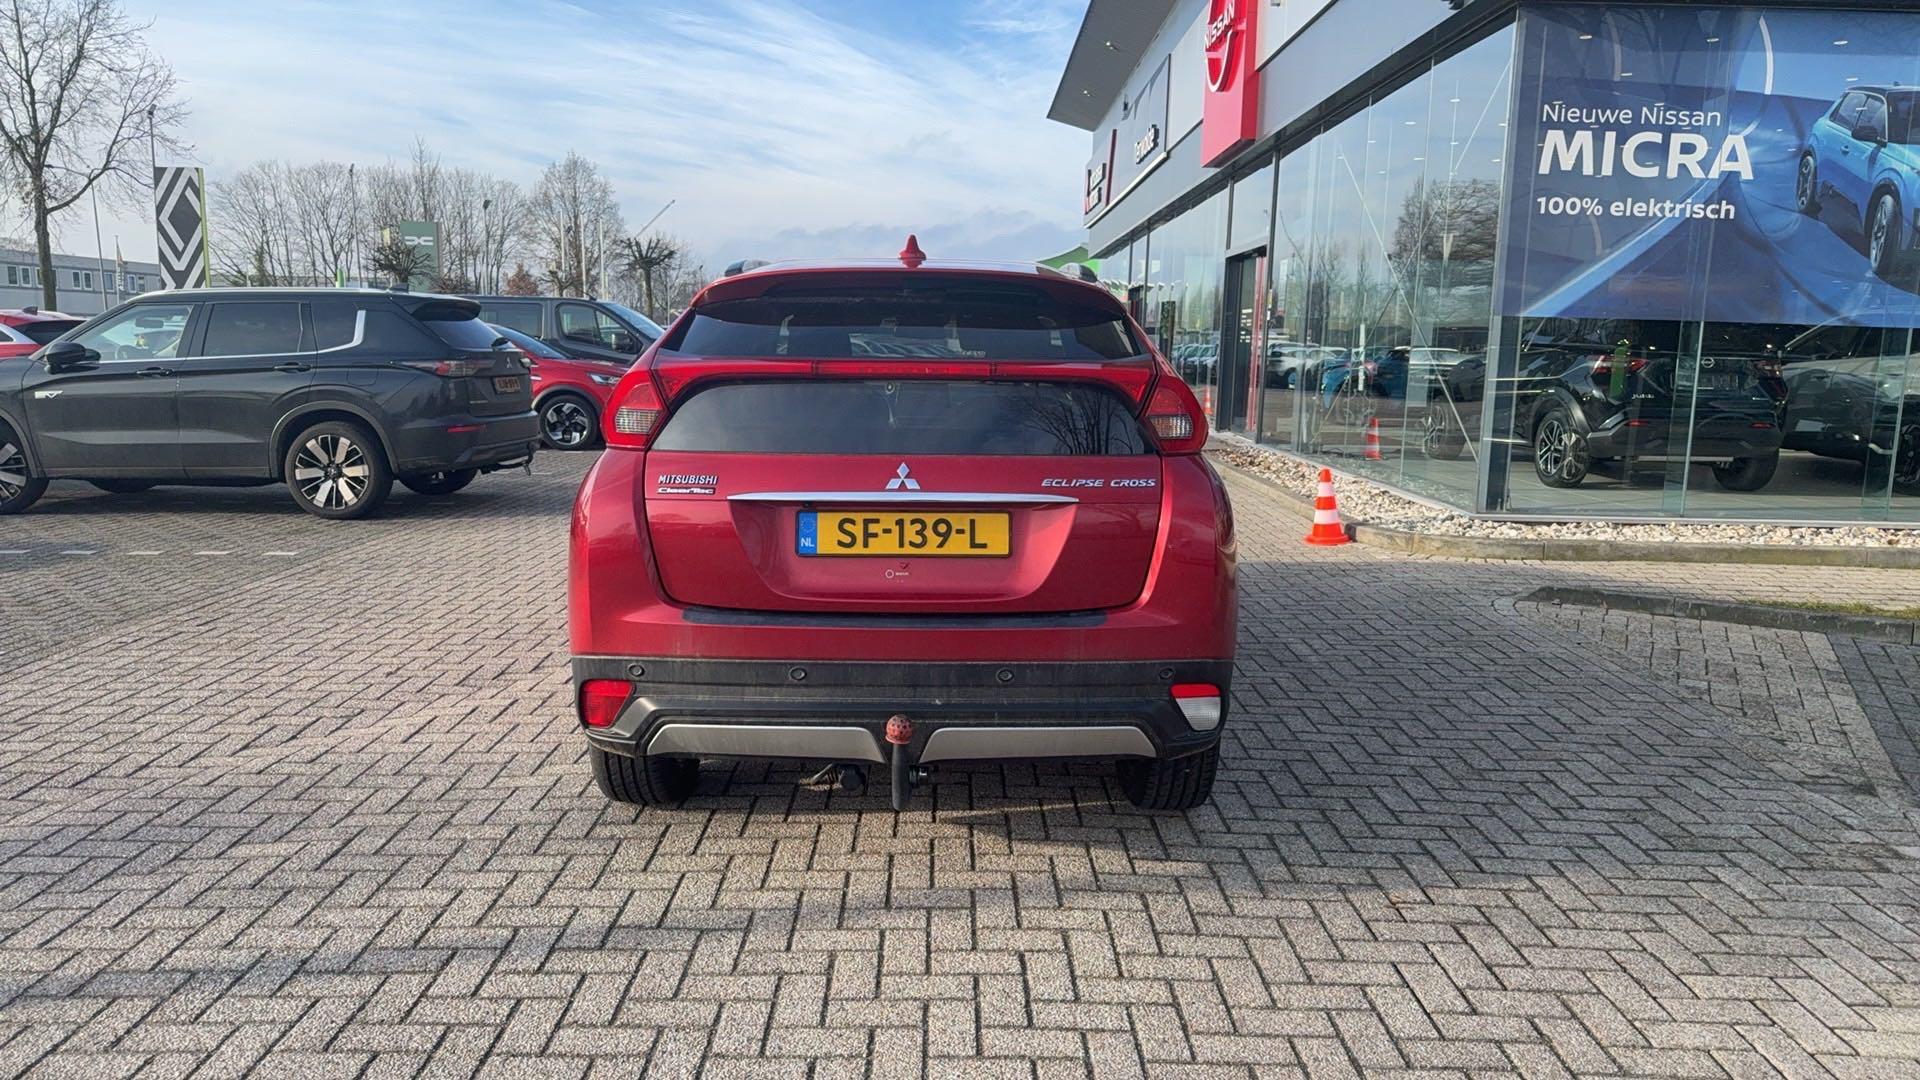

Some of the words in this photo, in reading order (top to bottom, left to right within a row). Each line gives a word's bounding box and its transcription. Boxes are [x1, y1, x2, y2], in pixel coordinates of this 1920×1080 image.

[1203, 2, 1235, 49] NISSAN
[1542, 103, 1633, 125] Nieuwe
[1640, 105, 1722, 127] Nissan
[1537, 129, 1755, 180] MICRA
[1537, 196, 1604, 217] 100%
[1609, 198, 1736, 220] elektrisch
[658, 474, 718, 485] MITSUBISHI
[1041, 478, 1104, 488] ECLIPSE
[1110, 478, 1157, 488] CROSS
[800, 537, 816, 548] NL
[836, 517, 989, 549] SF-139-L
